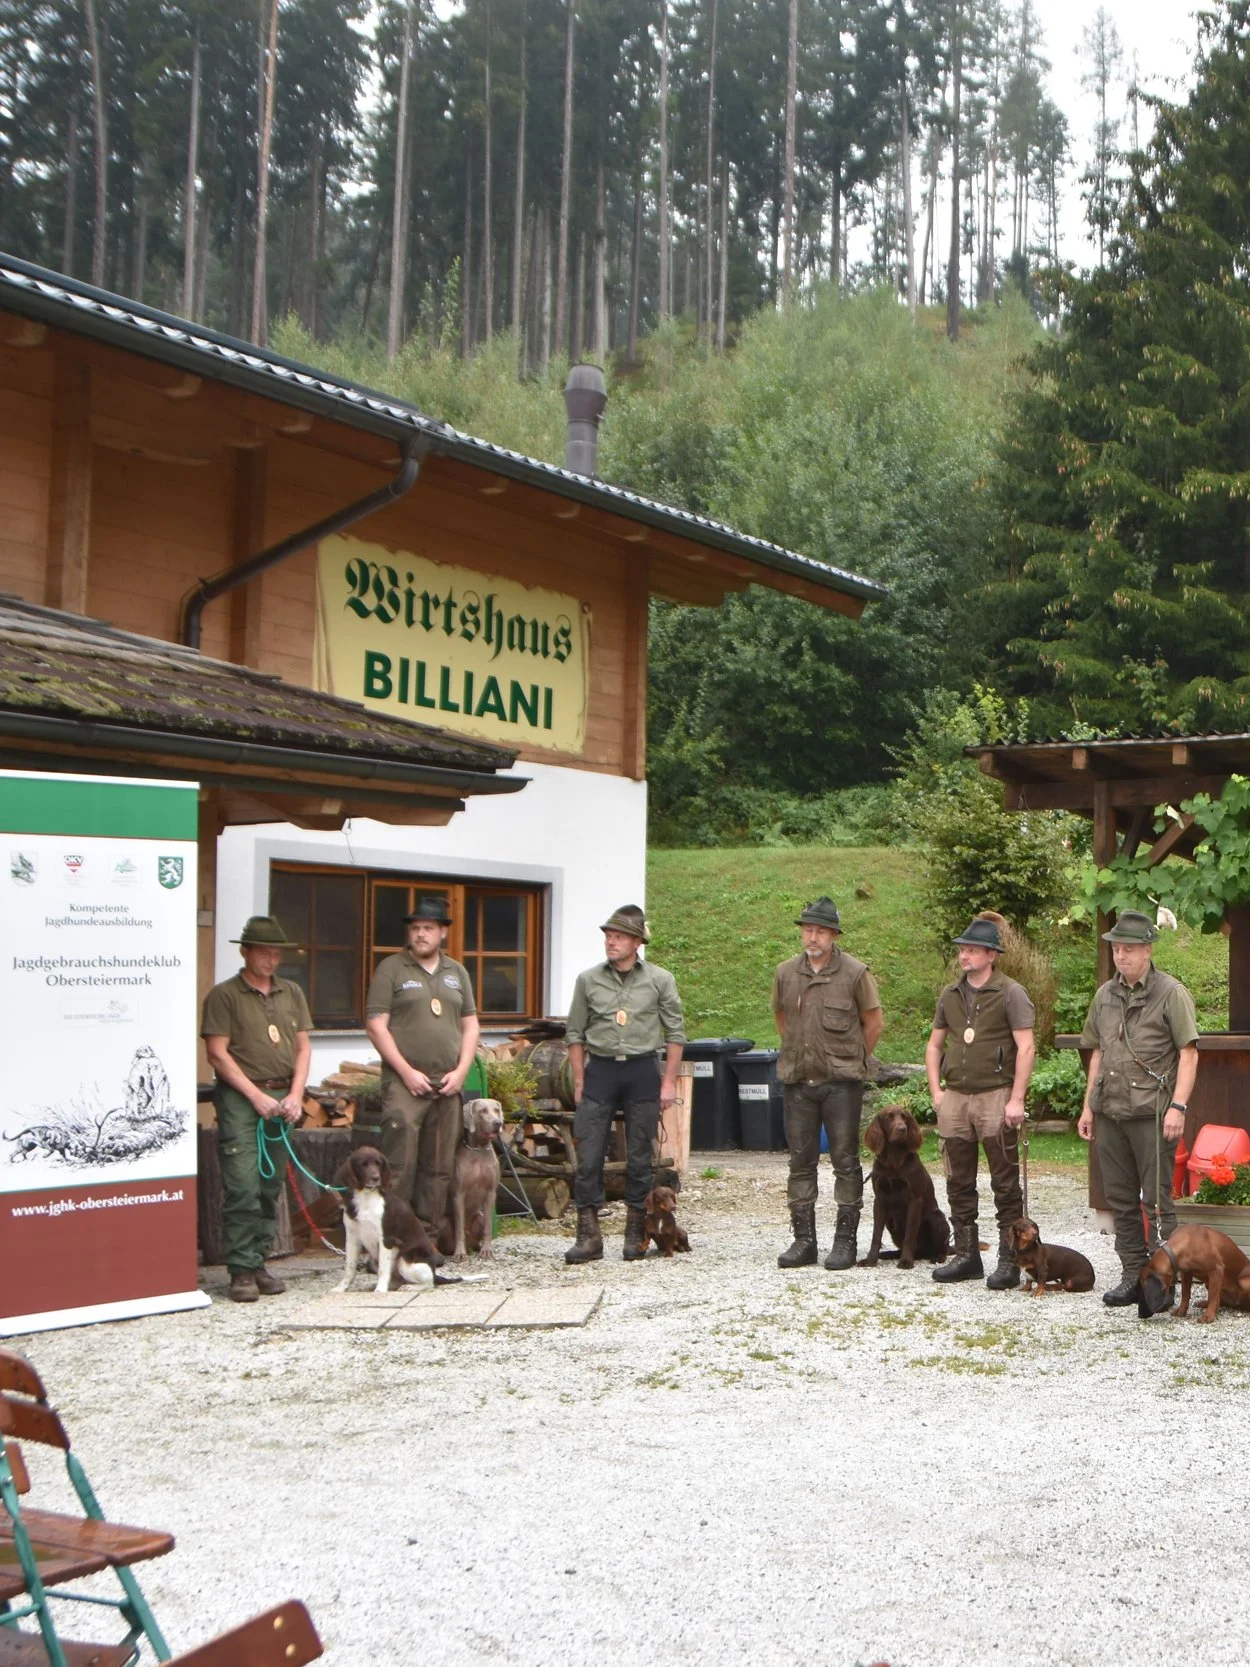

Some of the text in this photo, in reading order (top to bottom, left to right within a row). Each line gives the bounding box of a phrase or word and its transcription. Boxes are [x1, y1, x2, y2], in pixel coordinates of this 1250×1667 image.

[344, 557, 573, 664] Wirtshaus
[363, 649, 553, 730] BILLIANI
[69, 903, 130, 915] Kompetente
[45, 916, 153, 929] Jagdhundeausbildung
[12, 955, 182, 972] Jagdgebrauchshundeklub
[46, 973, 152, 987] Obersteiermark
[12, 1189, 184, 1217] www.jghk-obersteiermark.at
